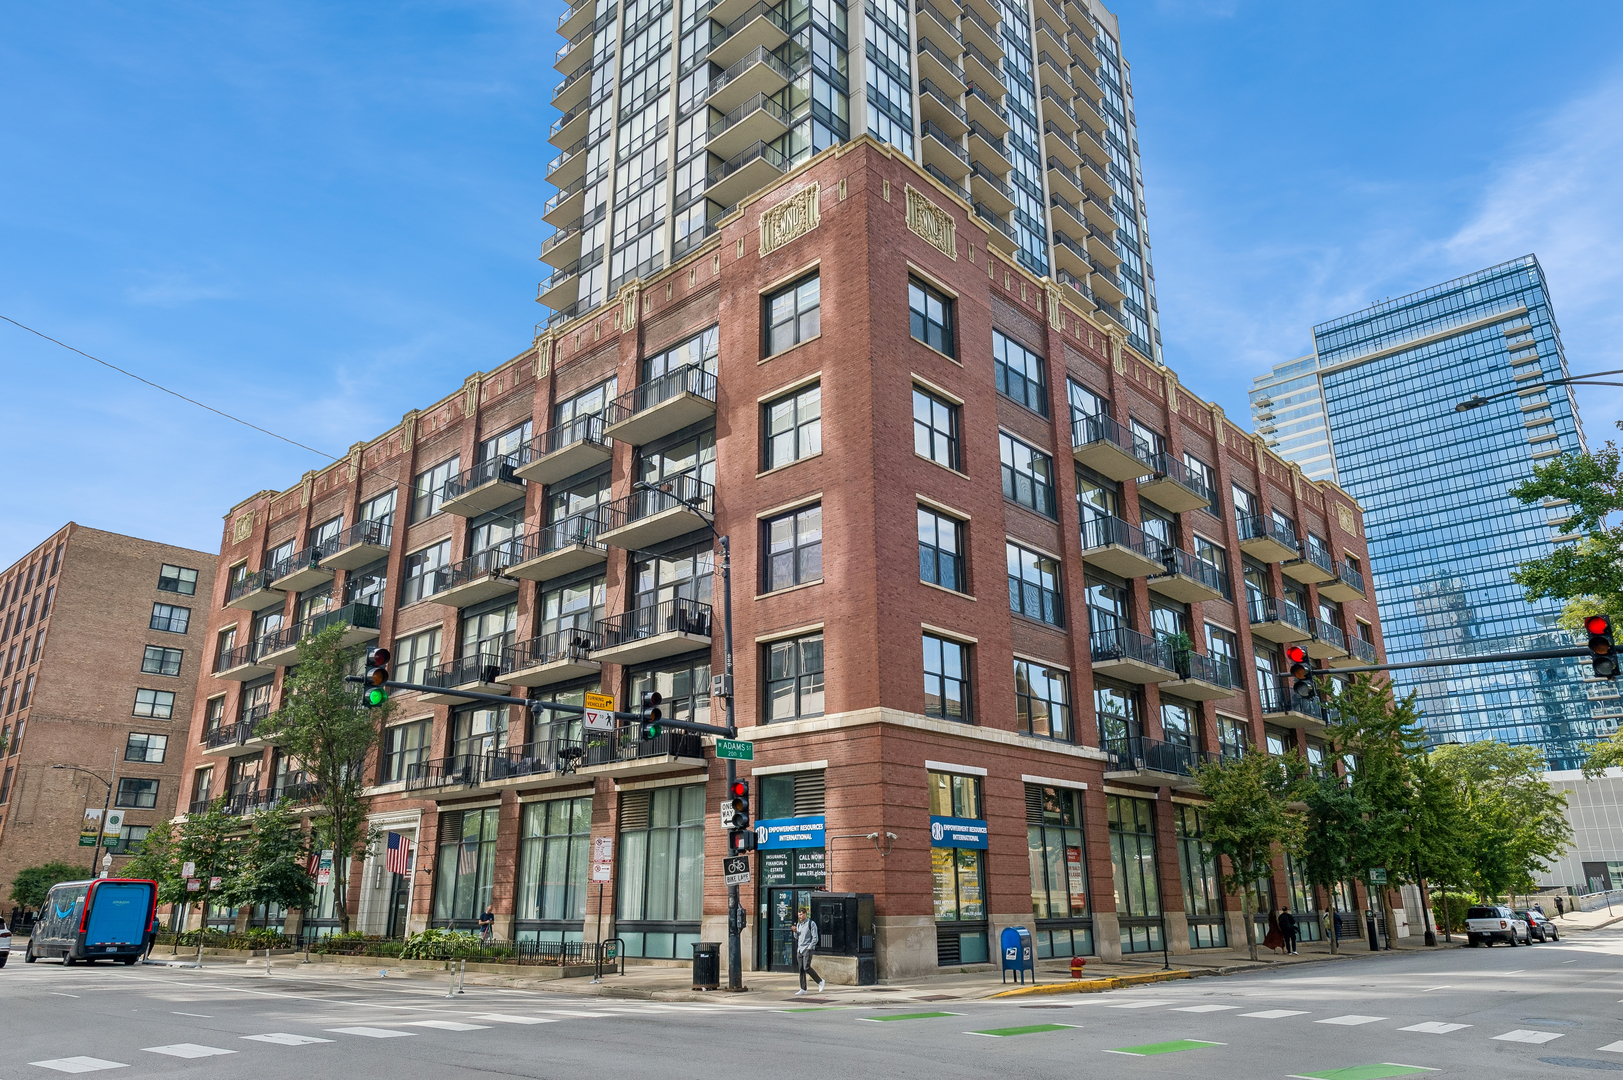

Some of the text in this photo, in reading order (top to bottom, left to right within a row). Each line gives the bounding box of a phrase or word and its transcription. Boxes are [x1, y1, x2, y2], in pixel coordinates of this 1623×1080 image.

[723, 742, 745, 751] ADAMS
[722, 802, 733, 810] ONE
[768, 825, 799, 833] EMPOWERMENT
[779, 833, 812, 841] INTERNATIONAL
[726, 873, 749, 883] BIKE LANE
